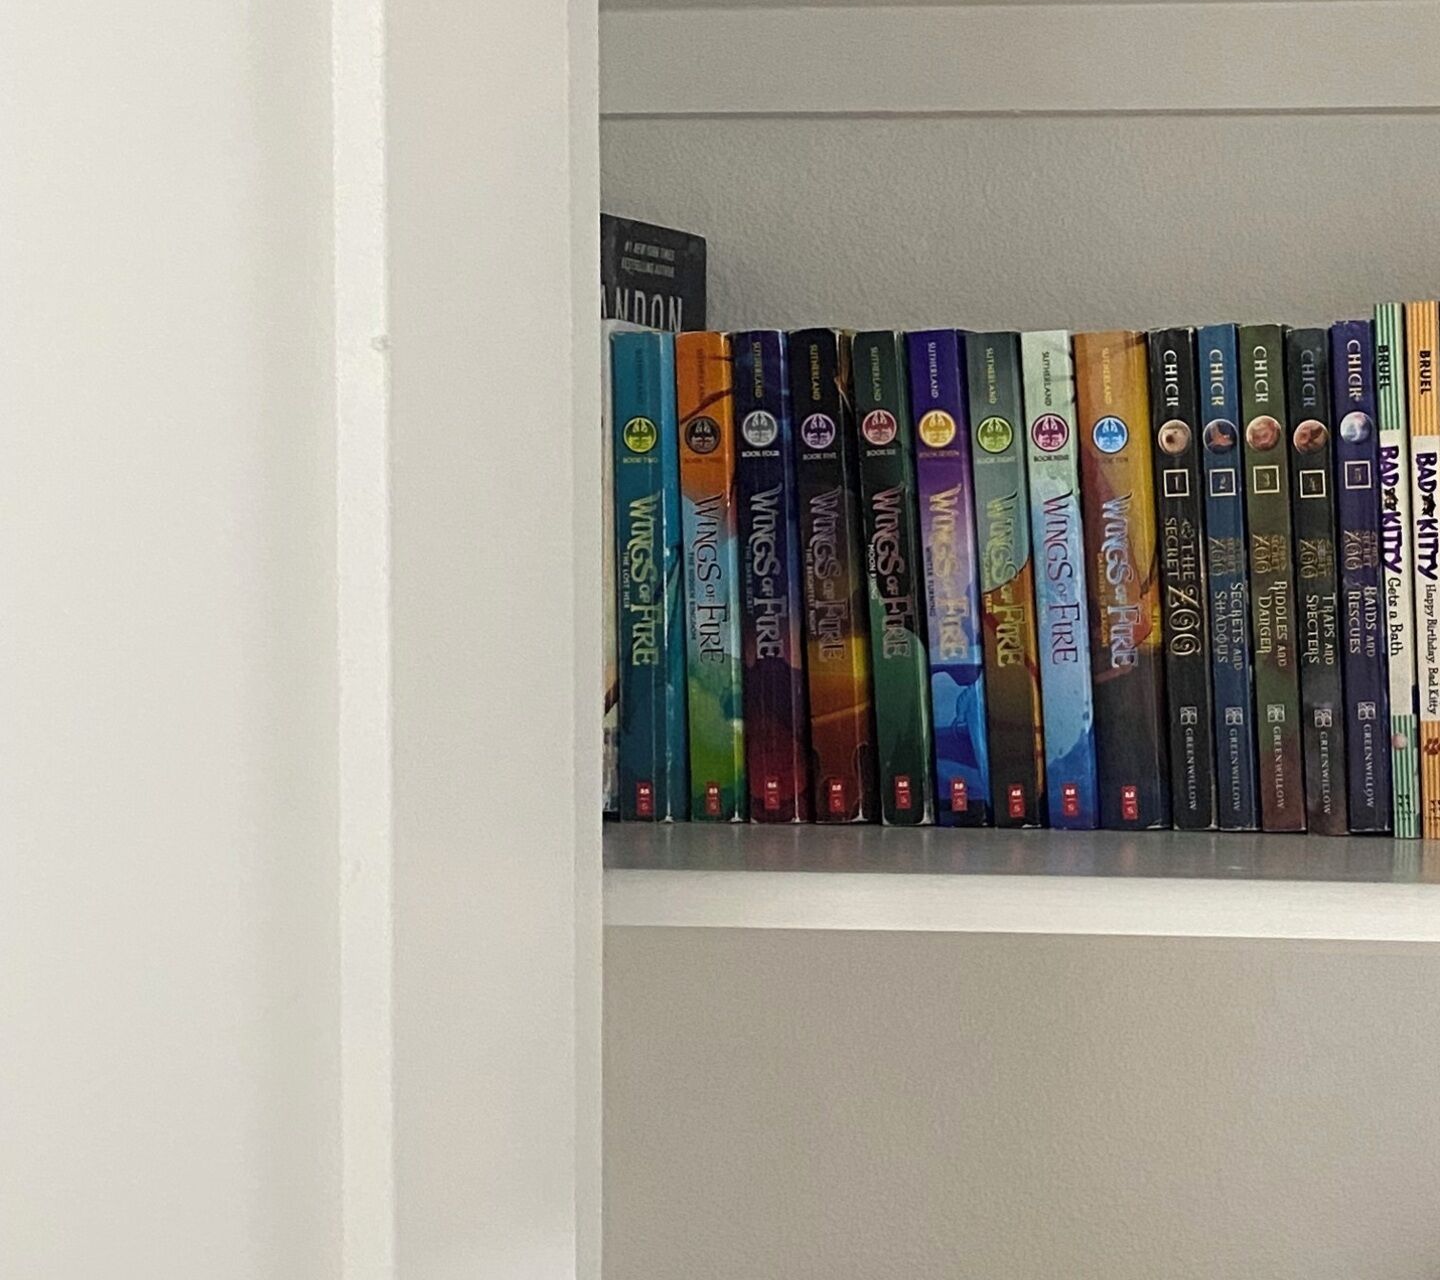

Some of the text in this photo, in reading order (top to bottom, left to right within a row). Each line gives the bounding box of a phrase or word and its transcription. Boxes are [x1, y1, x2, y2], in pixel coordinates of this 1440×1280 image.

[1209, 349, 1224, 406] CHICK
[1253, 346, 1269, 403] CHICK
[1419, 349, 1431, 395] BRUEL
[1042, 489, 1080, 665] WINGS OF FIRE
[1165, 517, 1180, 581] SECRET
[1257, 596, 1272, 654] DANGER
[1269, 581, 1288, 640] RIDDLES
[1364, 724, 1374, 808] GREENWILLOW
